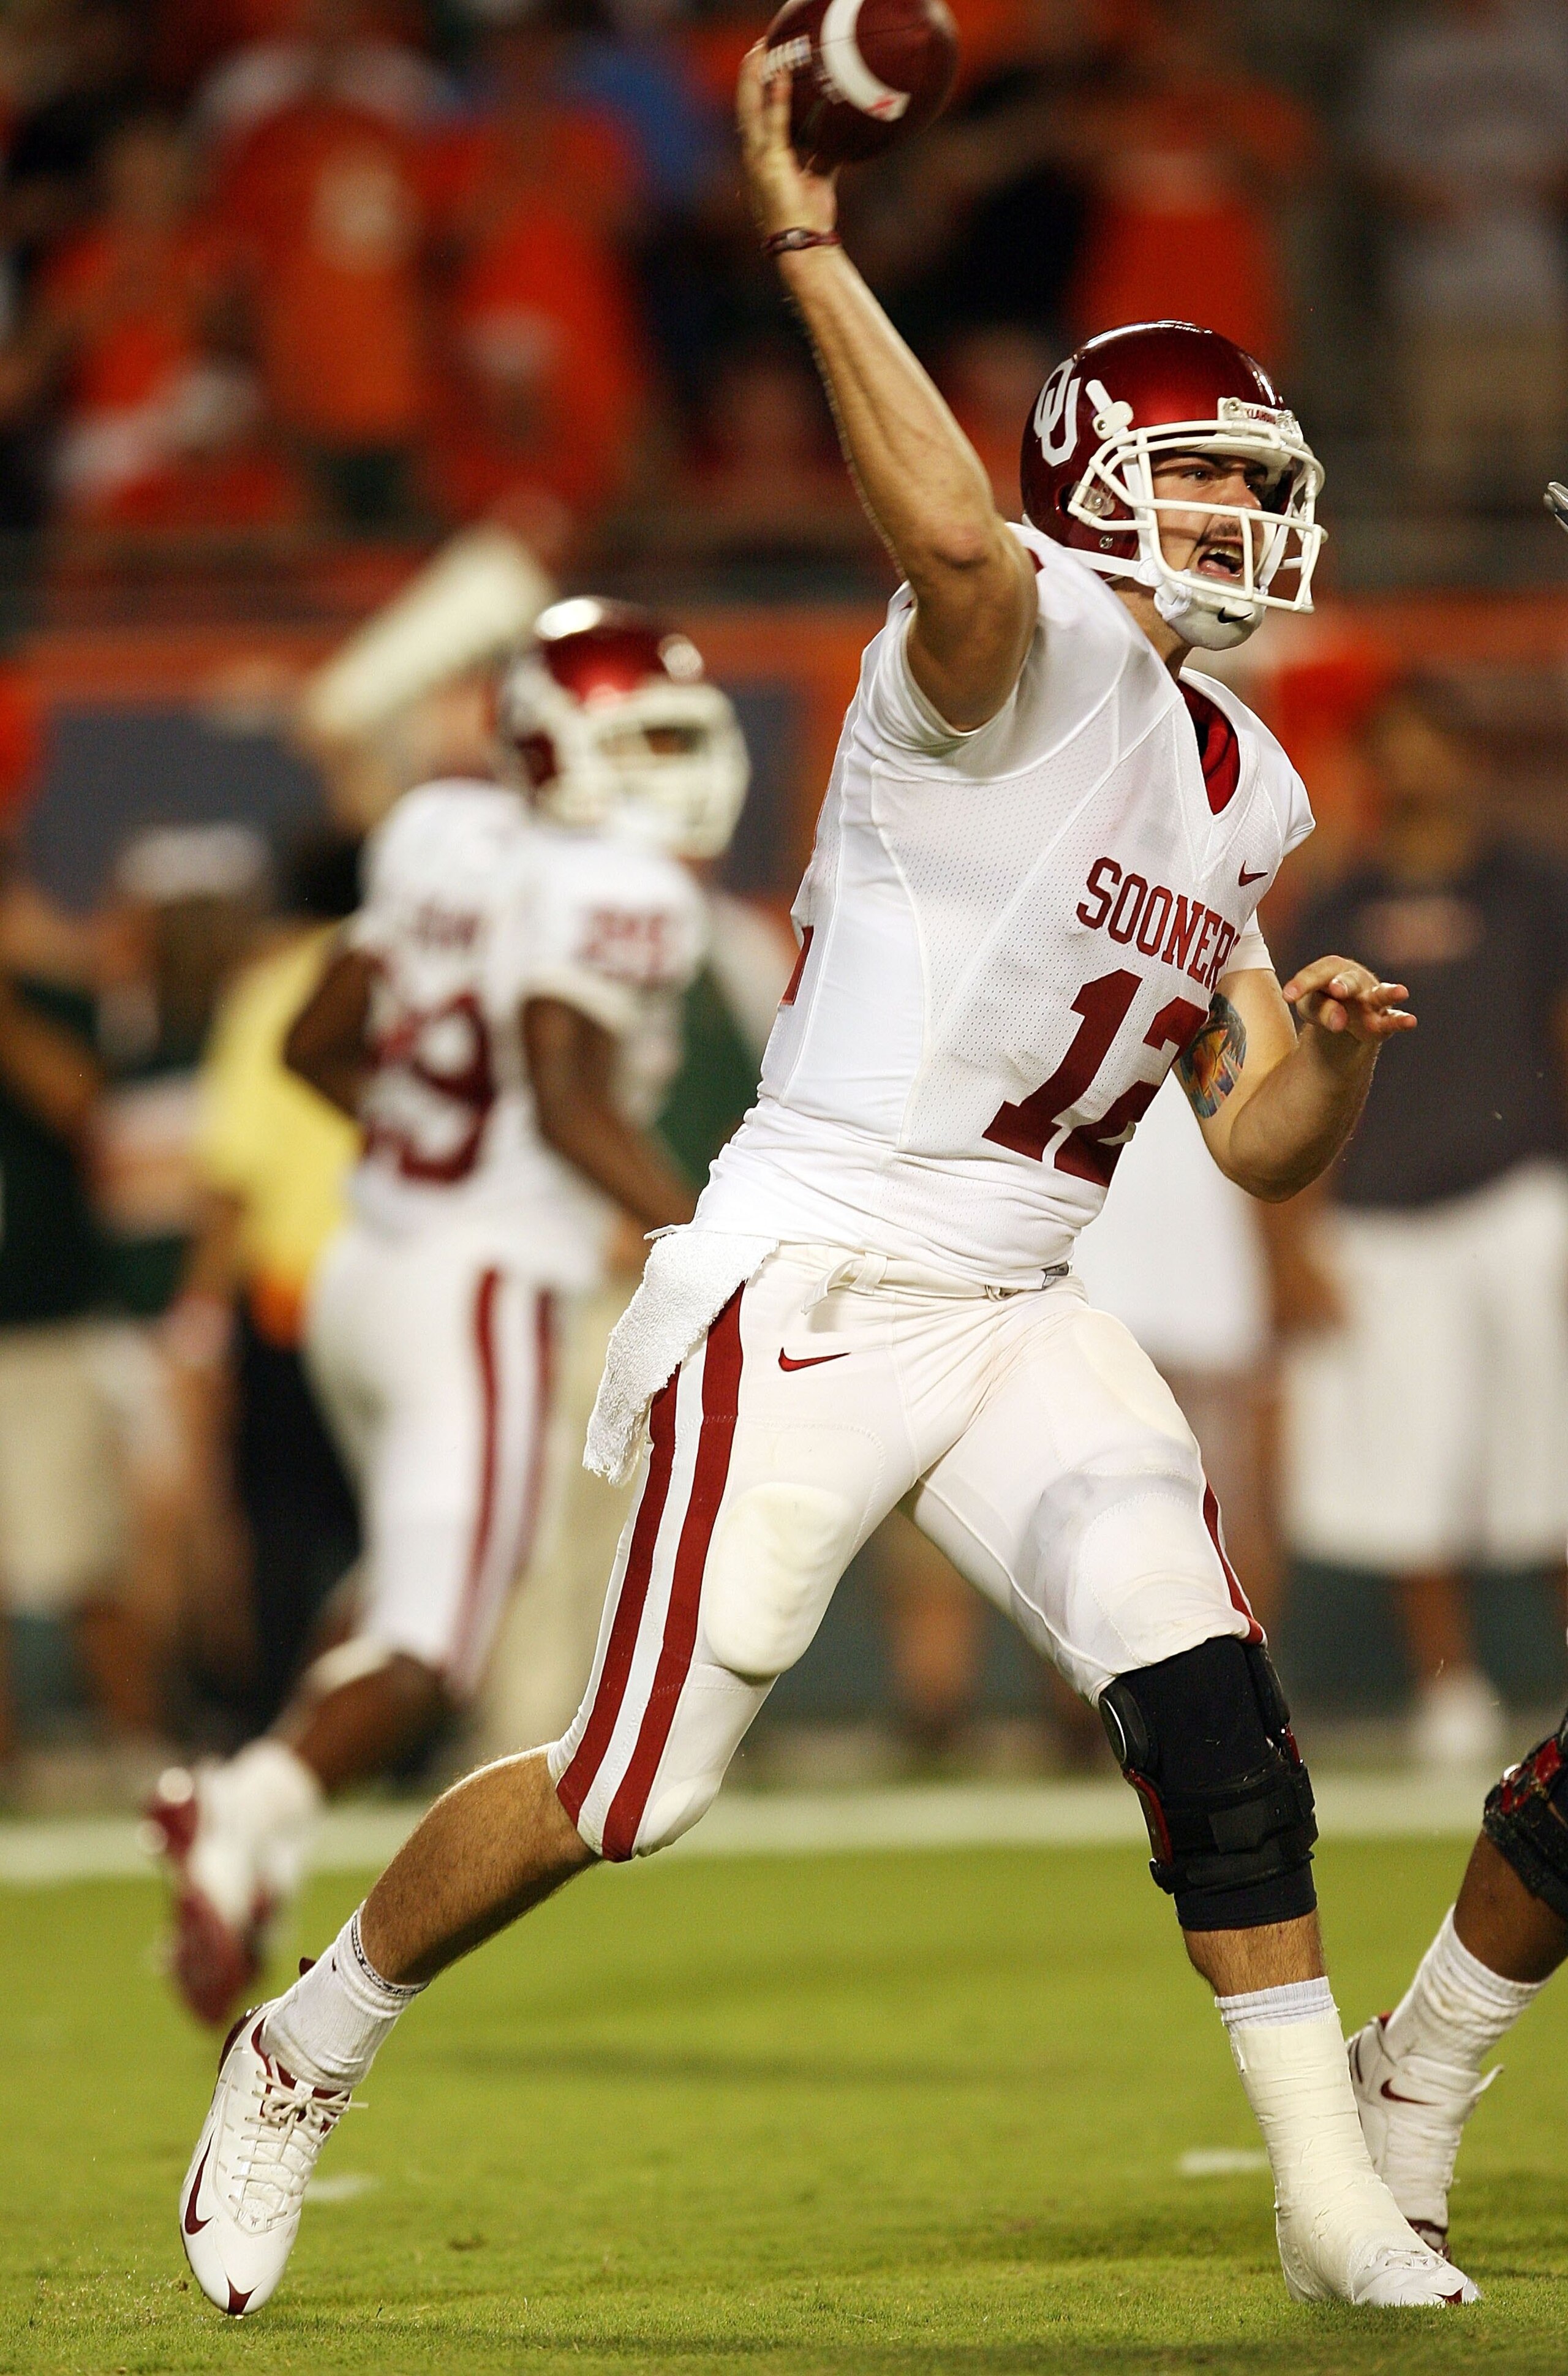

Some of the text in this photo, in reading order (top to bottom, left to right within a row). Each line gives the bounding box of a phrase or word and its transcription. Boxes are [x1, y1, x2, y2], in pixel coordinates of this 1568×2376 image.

[1033, 358, 1081, 467] OU
[1076, 857, 1241, 994] SOONER
[982, 968, 1209, 1188] 12
